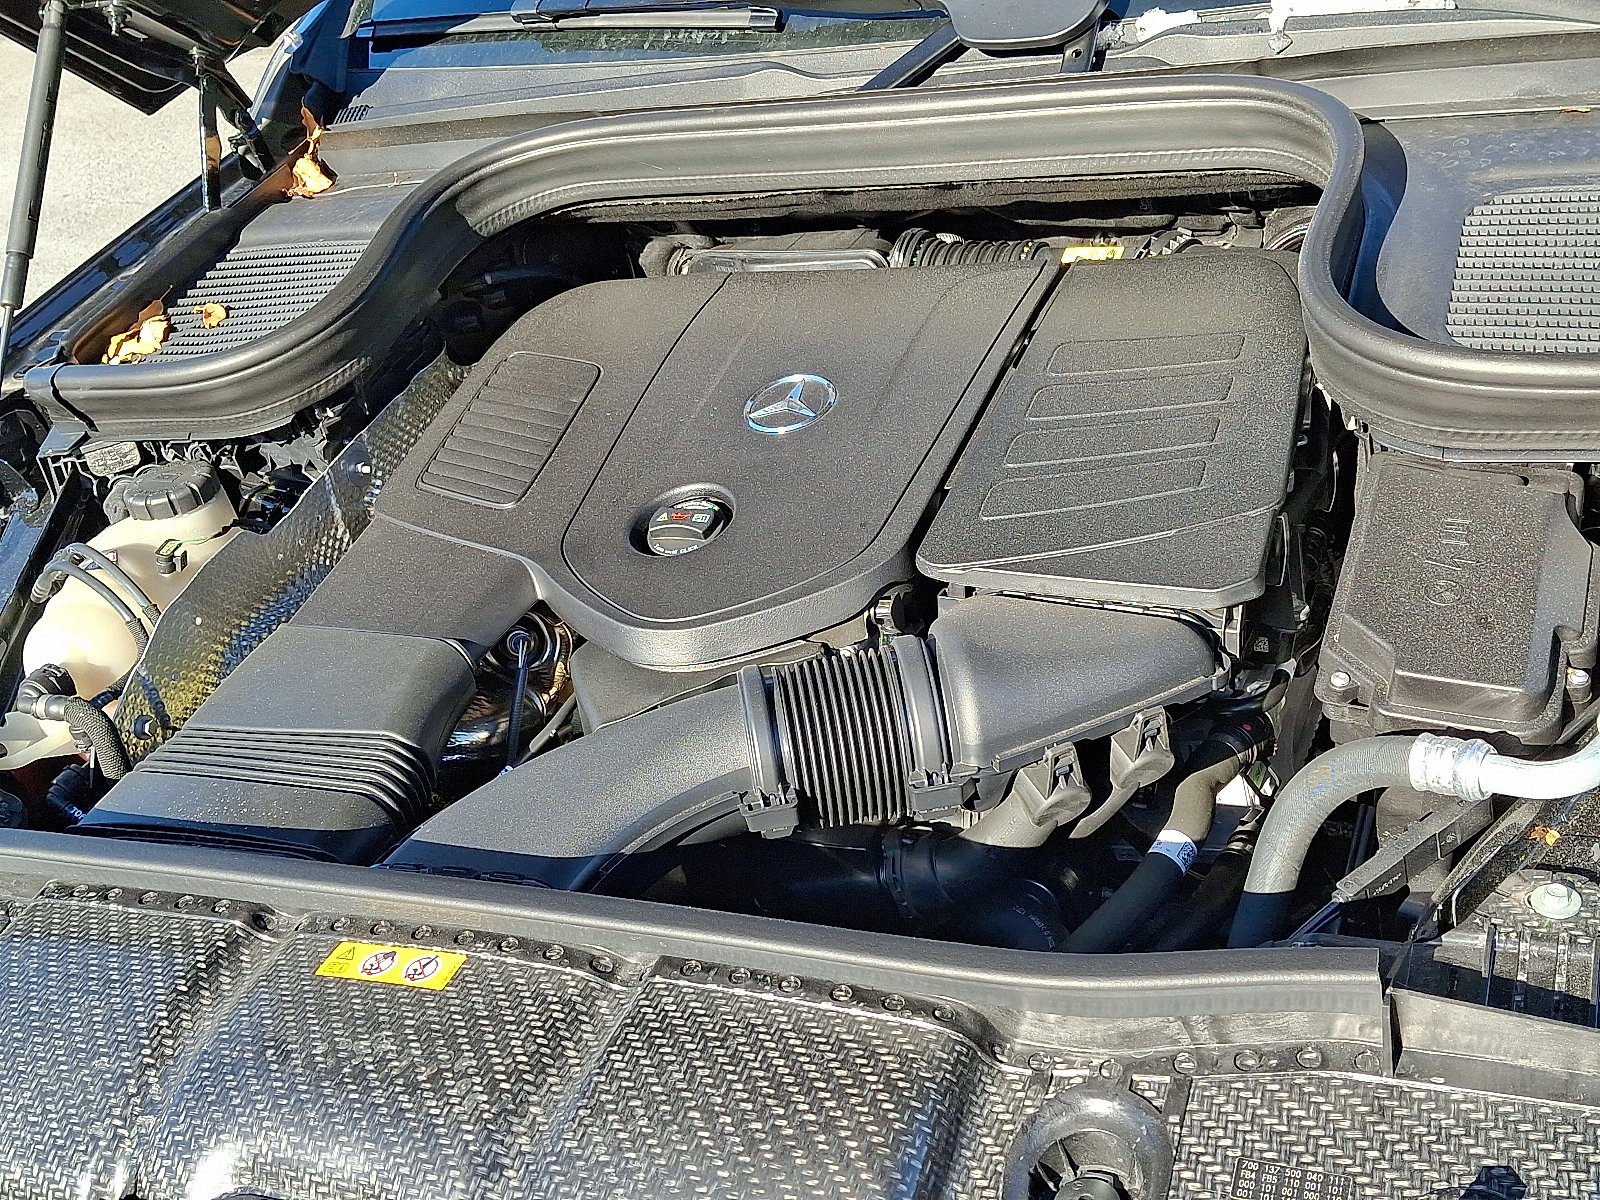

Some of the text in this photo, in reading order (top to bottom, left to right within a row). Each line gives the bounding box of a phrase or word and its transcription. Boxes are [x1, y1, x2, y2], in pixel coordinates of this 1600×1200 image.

[1240, 1170, 1343, 1195] FB4 FB5 110 001 101
[1242, 1160, 1344, 1186] 700 137 500 040 111
[1236, 1188, 1253, 1199] 001
[1238, 1180, 1255, 1189] 000
[1261, 1184, 1276, 1194] 101
[1281, 1187, 1297, 1197] 001
[1303, 1191, 1320, 1200] 000
